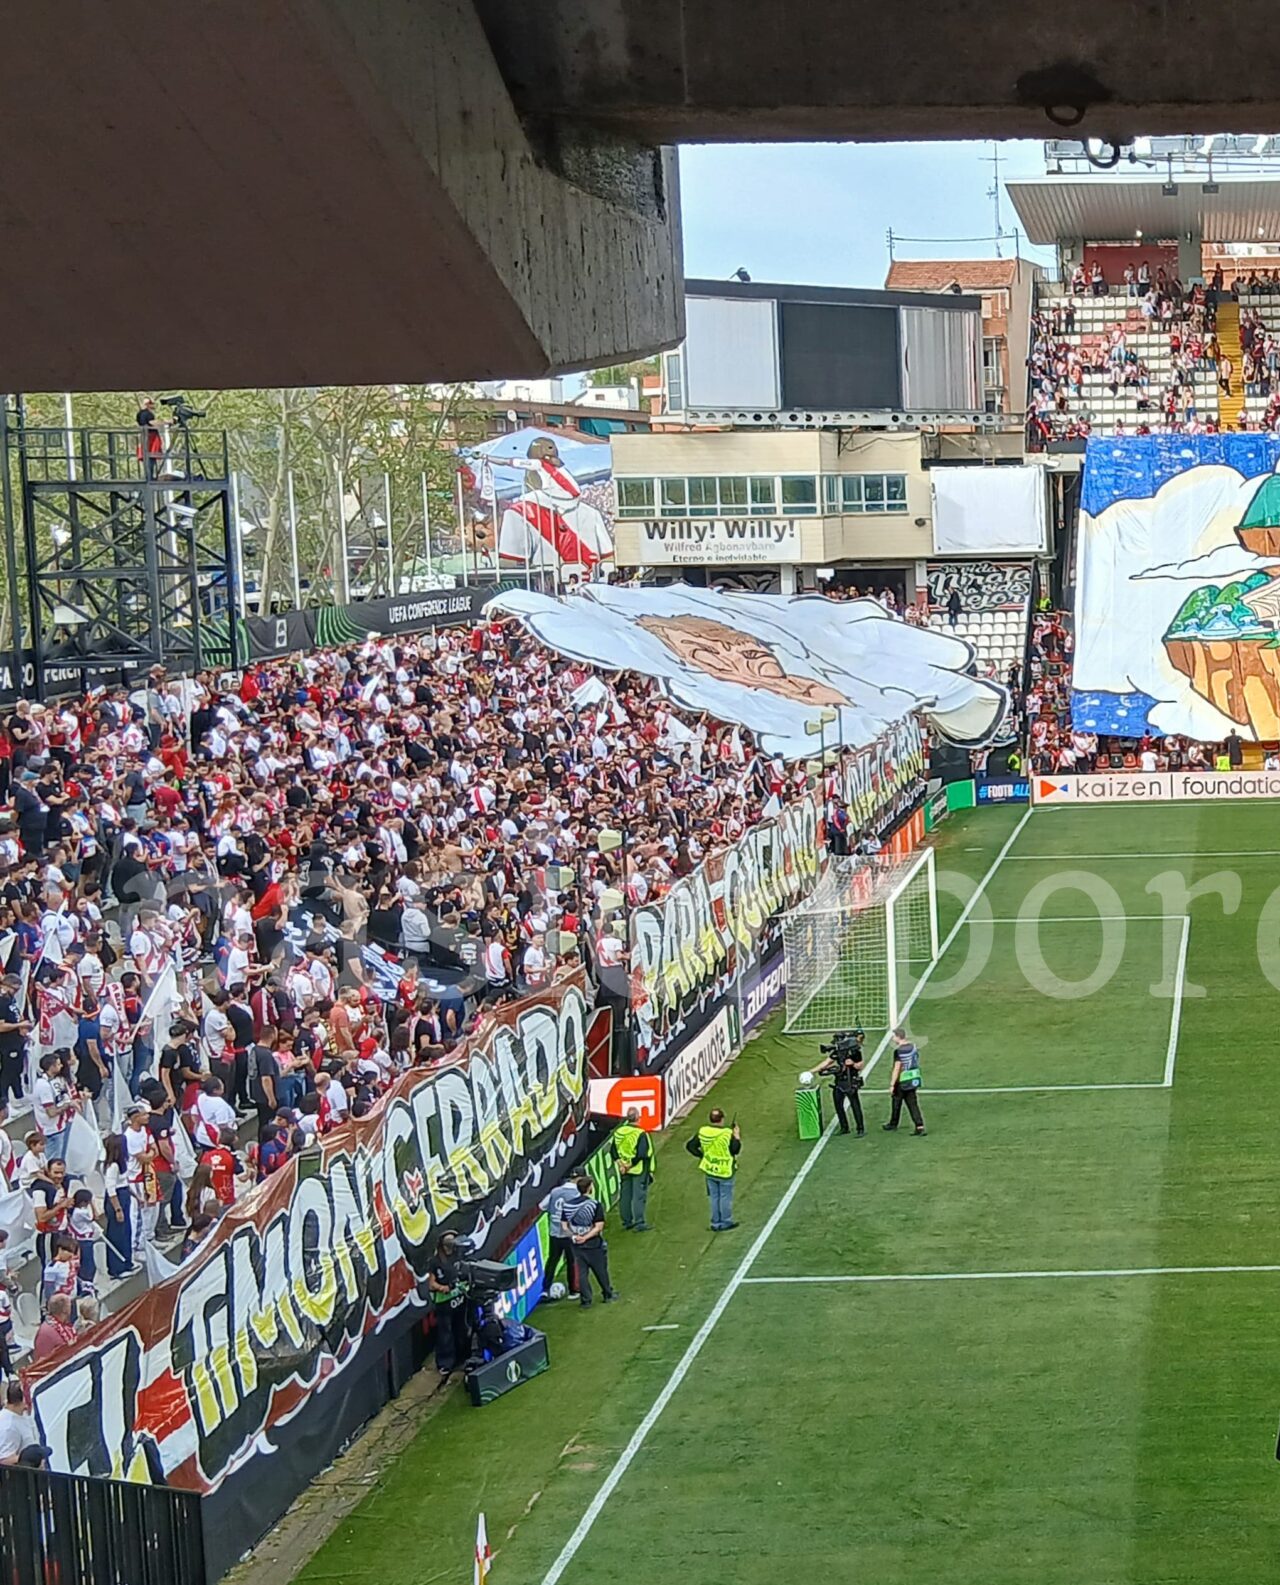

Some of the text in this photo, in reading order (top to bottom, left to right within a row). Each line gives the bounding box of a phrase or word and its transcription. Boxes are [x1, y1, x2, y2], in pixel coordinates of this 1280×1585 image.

[644, 520, 795, 543] Willy! Willy!
[664, 542, 702, 552] Wilfred
[389, 596, 473, 624] UEFA CONFERENCE LEAGUE
[1076, 777, 1162, 798] kaizen
[635, 866, 727, 1018] PARA
[666, 1022, 727, 1118] Swissquote
[383, 987, 587, 1246] CERRADO
